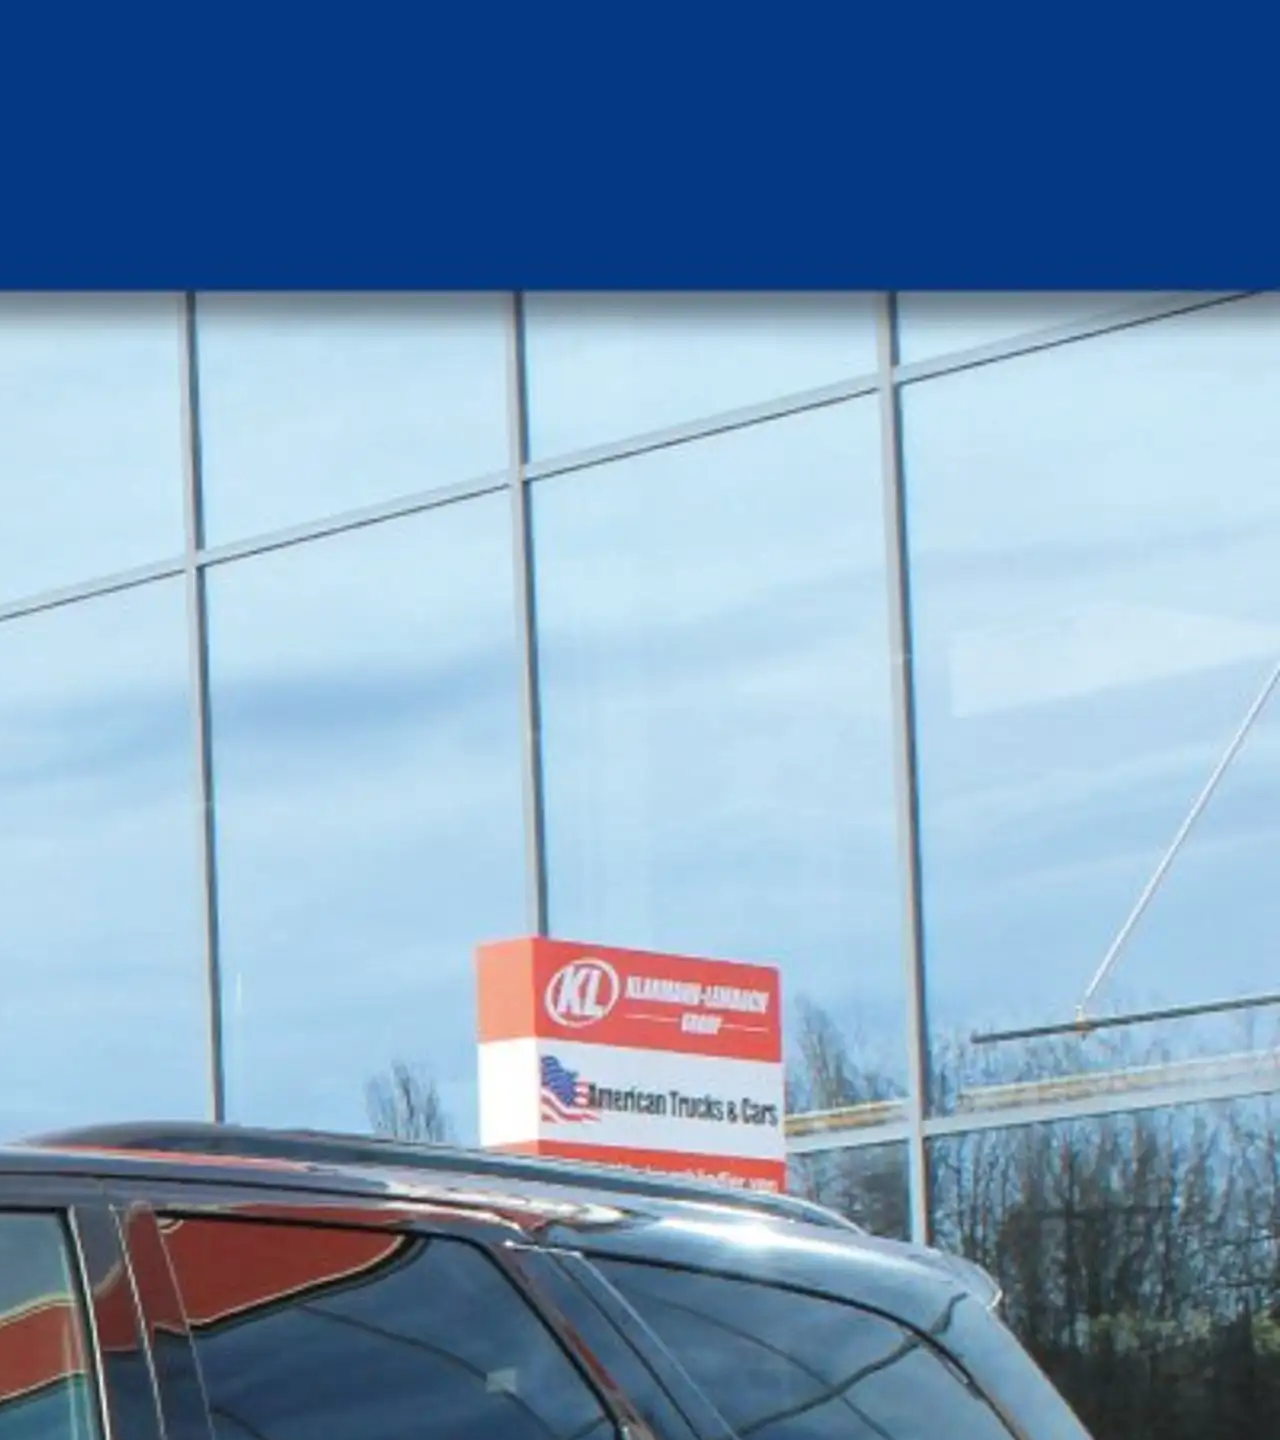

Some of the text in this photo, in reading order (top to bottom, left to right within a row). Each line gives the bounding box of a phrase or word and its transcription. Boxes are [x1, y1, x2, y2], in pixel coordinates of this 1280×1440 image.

[556, 965, 606, 1019] KL
[588, 1083, 667, 1117] American
[670, 1090, 724, 1122] Trucks
[742, 1098, 778, 1127] Cars
